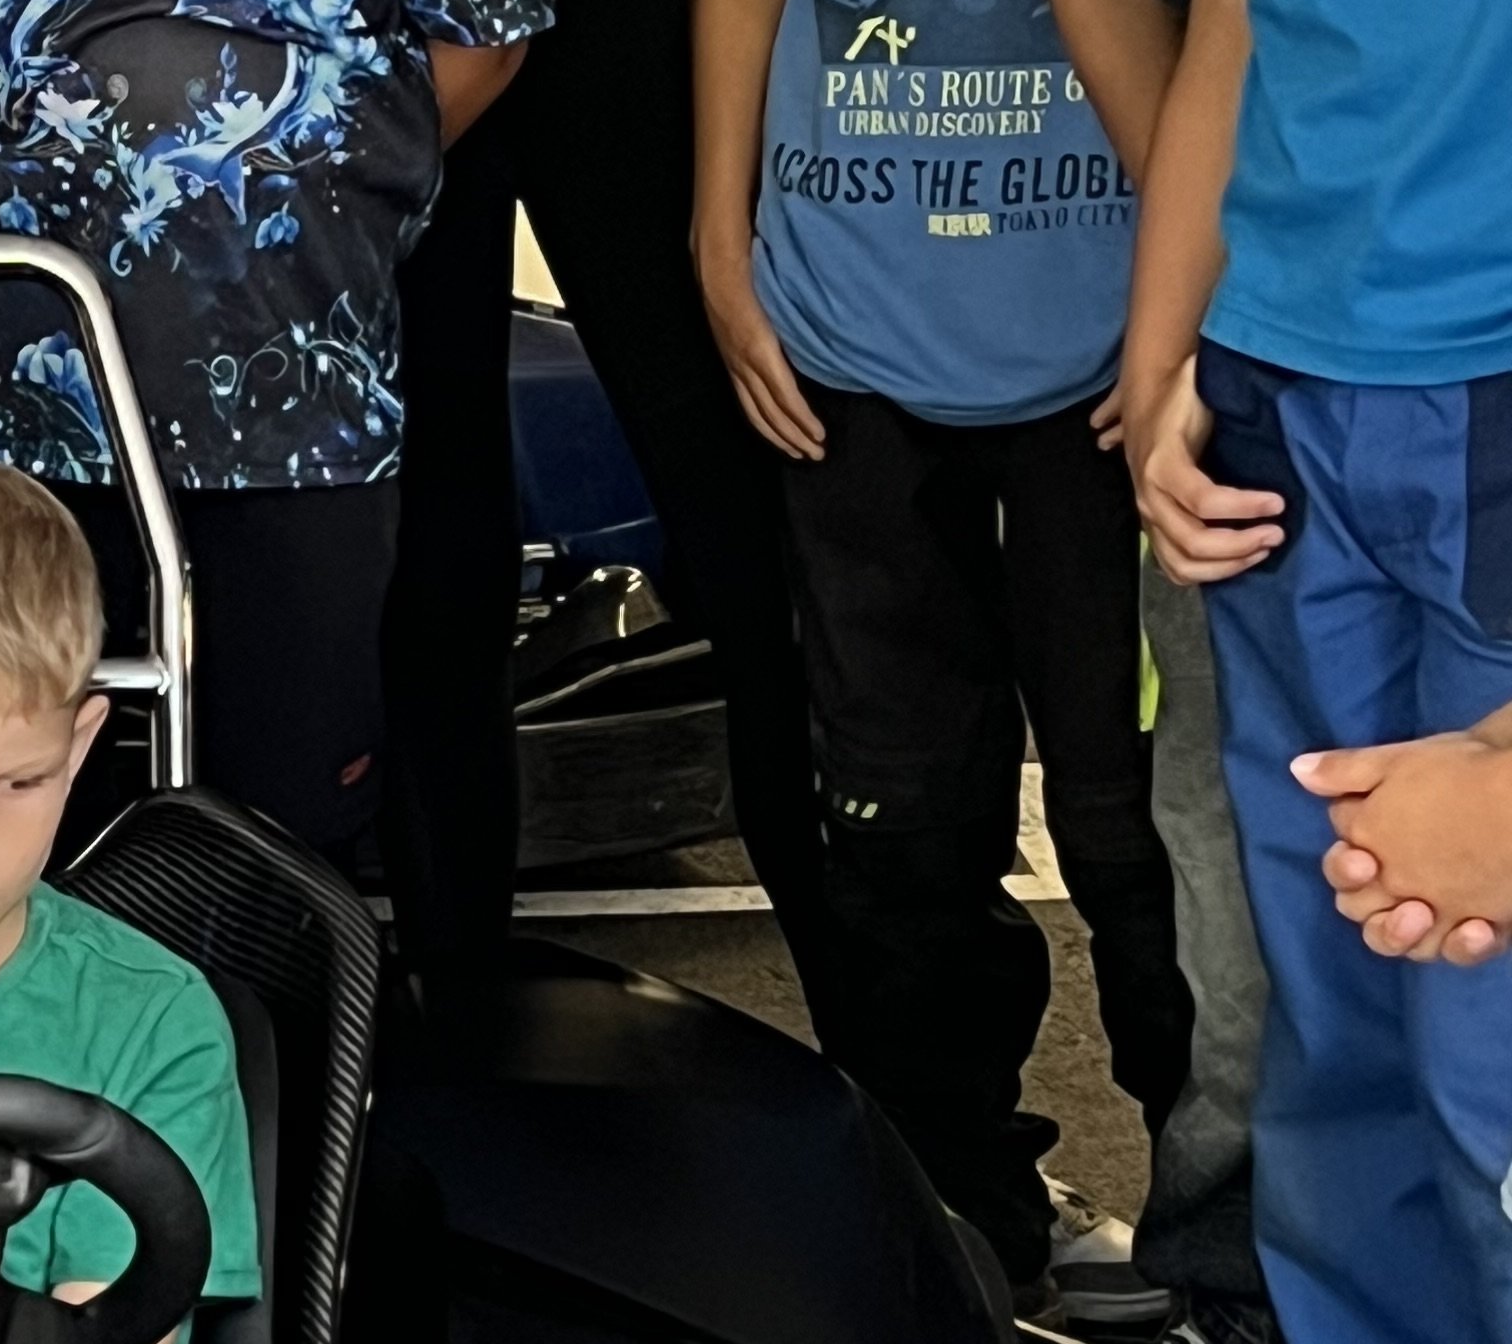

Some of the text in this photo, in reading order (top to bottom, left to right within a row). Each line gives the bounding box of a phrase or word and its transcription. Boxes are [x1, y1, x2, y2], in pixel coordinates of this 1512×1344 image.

[941, 69, 1052, 107] ROUTE
[838, 108, 1047, 137] URBAN DISCOVERY
[912, 158, 984, 208] THE
